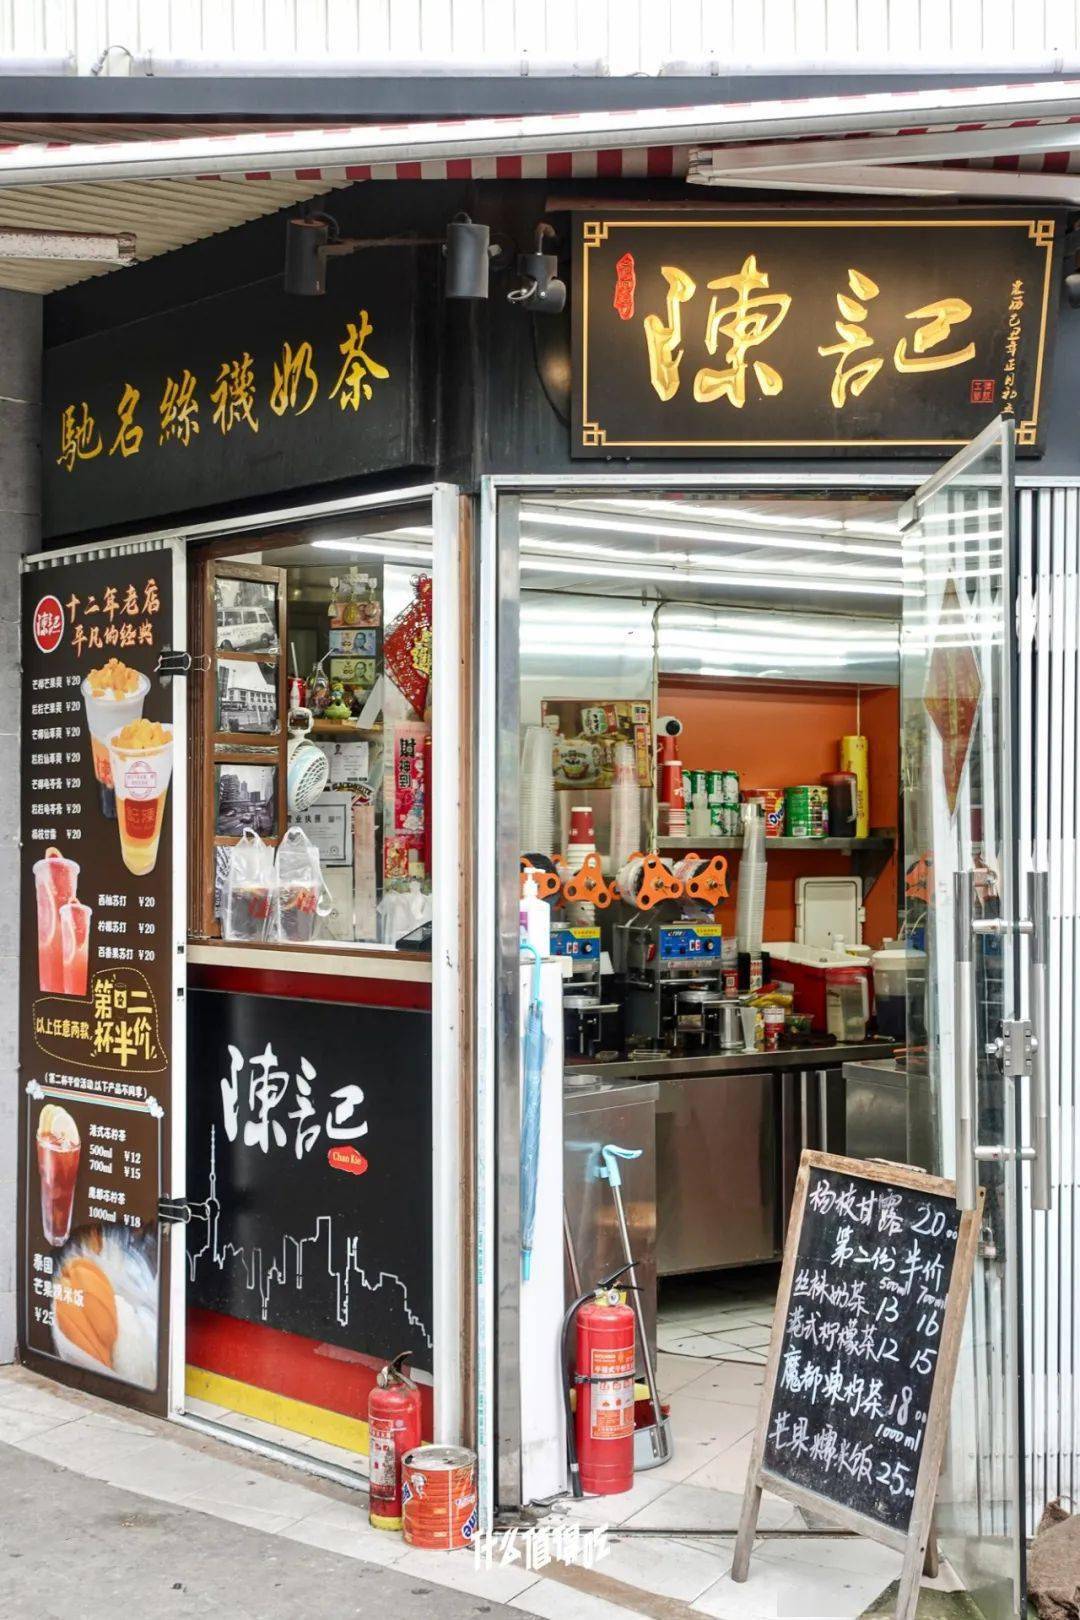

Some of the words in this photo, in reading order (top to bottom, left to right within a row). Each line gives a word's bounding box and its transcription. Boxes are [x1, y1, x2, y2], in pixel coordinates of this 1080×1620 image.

[643, 254, 977, 408] 陳記
[66, 579, 160, 624] 十二年老店
[71, 619, 154, 657] 平凡的经典
[66, 675, 81, 686] ¥20
[65, 701, 81, 712] ¥20
[65, 726, 81, 737] ¥20
[65, 752, 81, 762] ¥20
[65, 777, 81, 788] ¥20
[66, 803, 82, 814] ¥20
[66, 828, 82, 839] ¥20
[138, 896, 155, 907] ¥20
[138, 923, 155, 934] ¥20
[138, 950, 155, 961] ¥20
[220, 1042, 369, 1160] 陳記
[89, 1144, 113, 1159] 500ml
[124, 1150, 141, 1164] ¥12
[89, 1160, 113, 1174] 700ml
[124, 1166, 141, 1180] ¥15
[88, 1206, 117, 1222] 1000ml
[124, 1214, 141, 1228] ¥18
[876, 1296, 899, 1322] 13
[917, 1310, 939, 1336] 16
[876, 1337, 900, 1363] 12
[910, 1348, 938, 1375] 15
